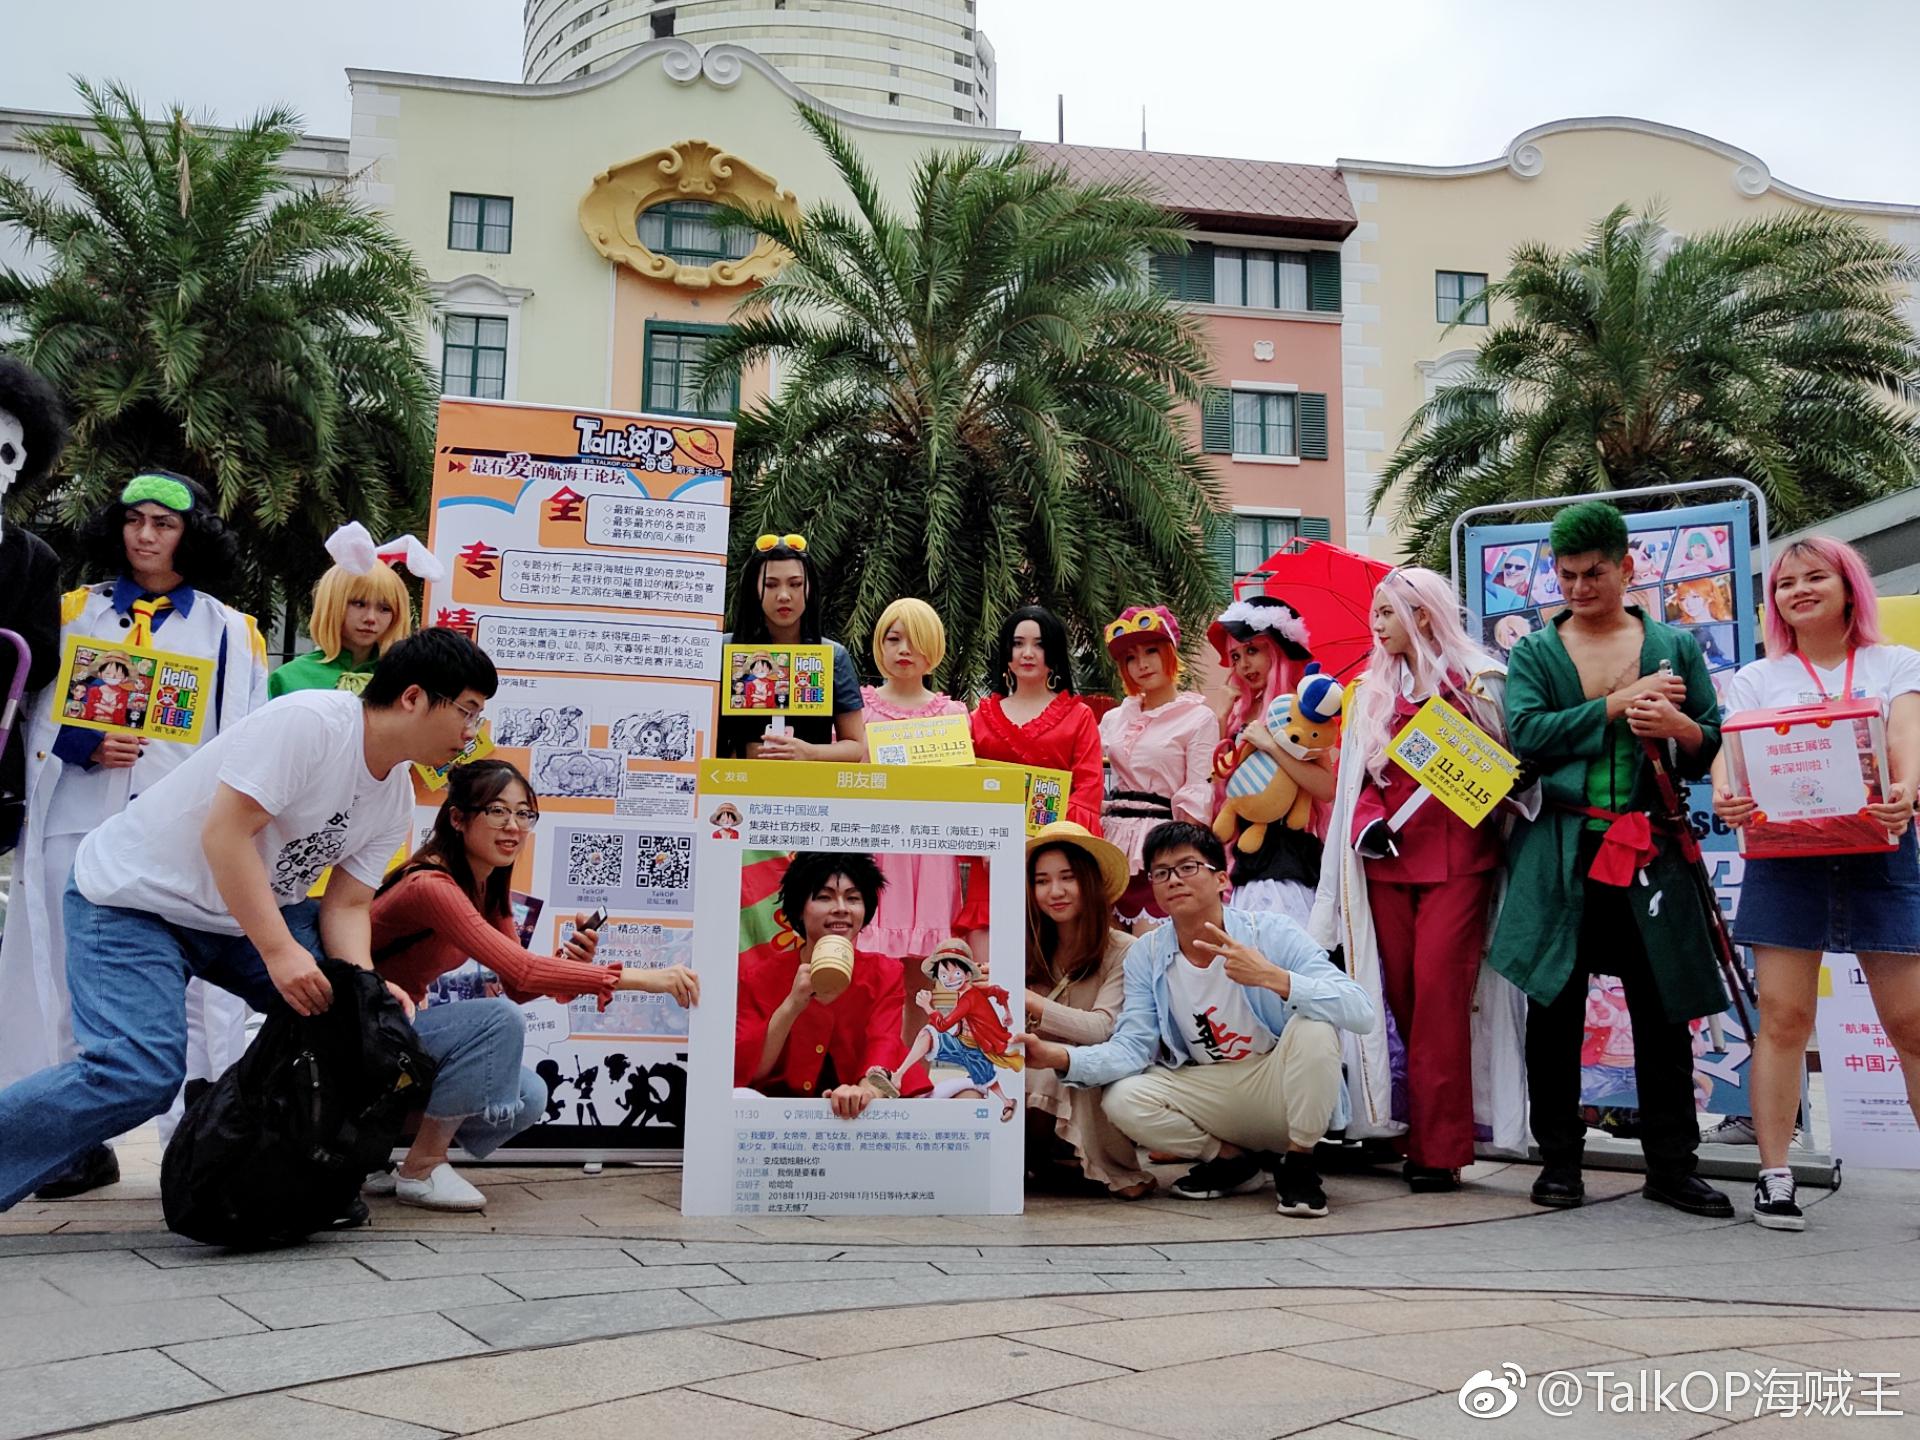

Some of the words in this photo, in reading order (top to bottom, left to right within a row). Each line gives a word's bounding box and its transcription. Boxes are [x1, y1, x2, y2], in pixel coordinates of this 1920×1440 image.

[574, 416, 674, 458] TalkOP
[471, 453, 626, 486] 最有爱的航海王论坛
[547, 485, 586, 521] 全
[613, 504, 706, 520] 最新最全的各类资讯
[458, 540, 499, 579] 专
[794, 687, 825, 703] PIECE
[151, 704, 195, 729] PIECE
[1765, 737, 1832, 756] 海贼王展览
[725, 771, 748, 783] 发现
[836, 771, 887, 790] 朋友圈
[749, 803, 829, 817] 航海王中国巡展
[734, 1110, 760, 1119] 11:30
[768, 1180, 794, 1190] 哈哈哈
